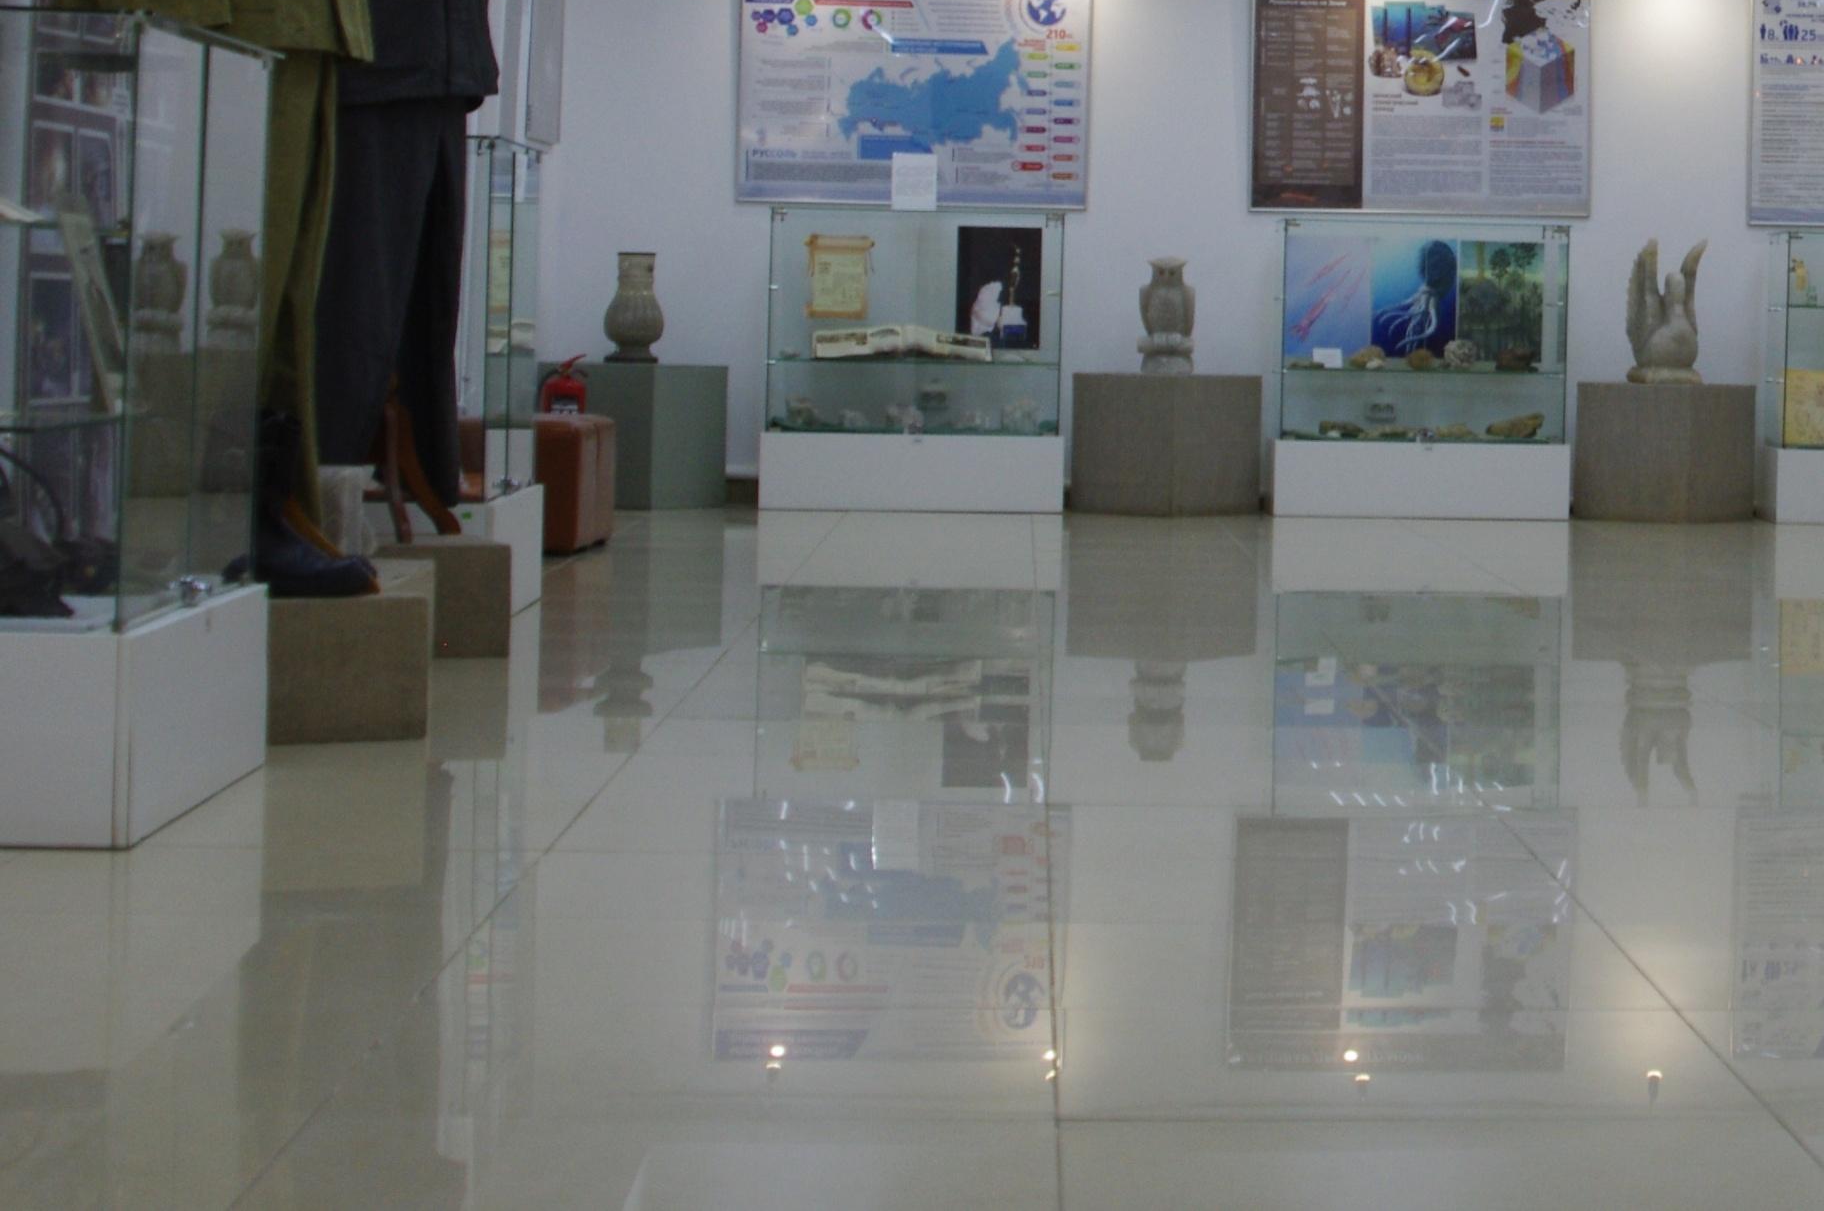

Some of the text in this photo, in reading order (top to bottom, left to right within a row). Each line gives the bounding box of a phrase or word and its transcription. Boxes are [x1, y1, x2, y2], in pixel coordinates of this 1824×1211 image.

[1046, 29, 1066, 39] 210
[1767, 29, 1775, 41] 8
[1801, 29, 1817, 41] 25
